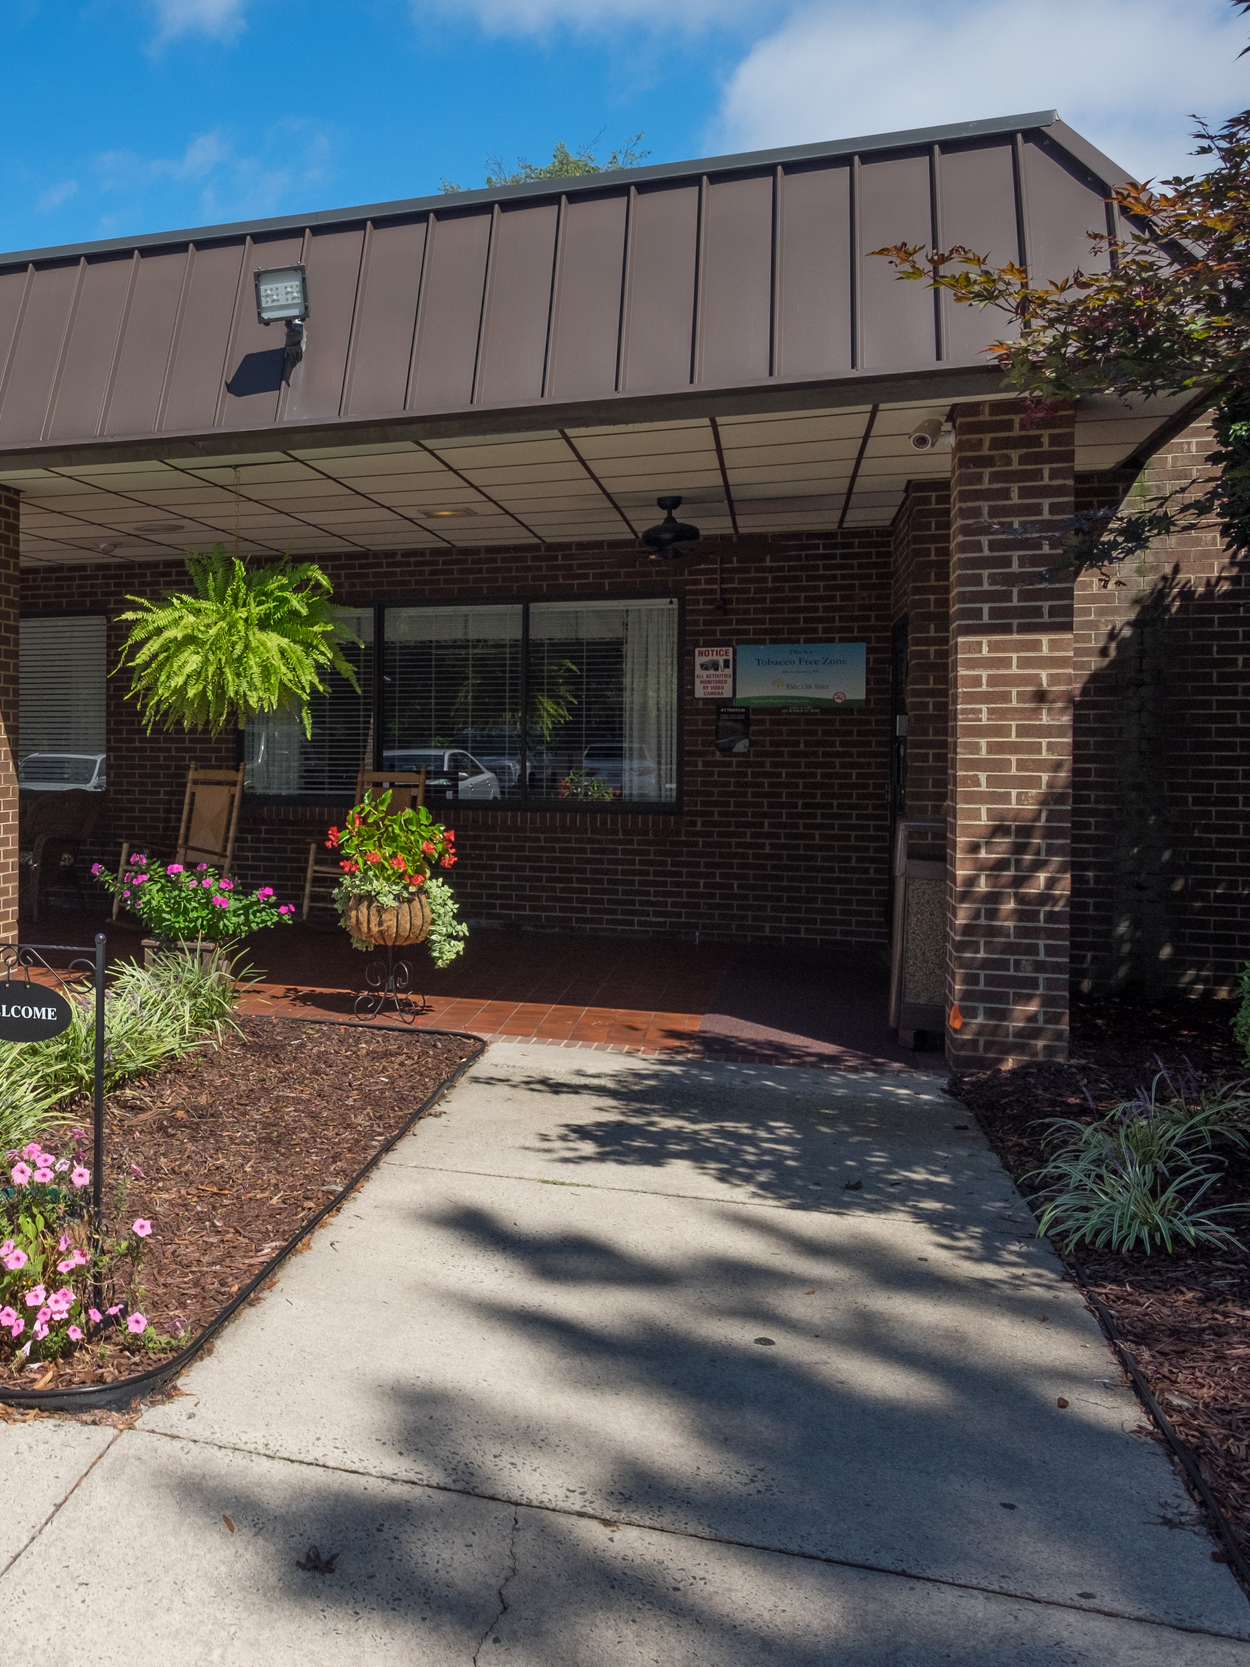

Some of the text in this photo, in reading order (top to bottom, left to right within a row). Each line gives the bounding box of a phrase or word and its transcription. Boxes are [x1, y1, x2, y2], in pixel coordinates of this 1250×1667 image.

[697, 649, 730, 657] NOTICE
[755, 657, 847, 666] Tobacco Free Zone
